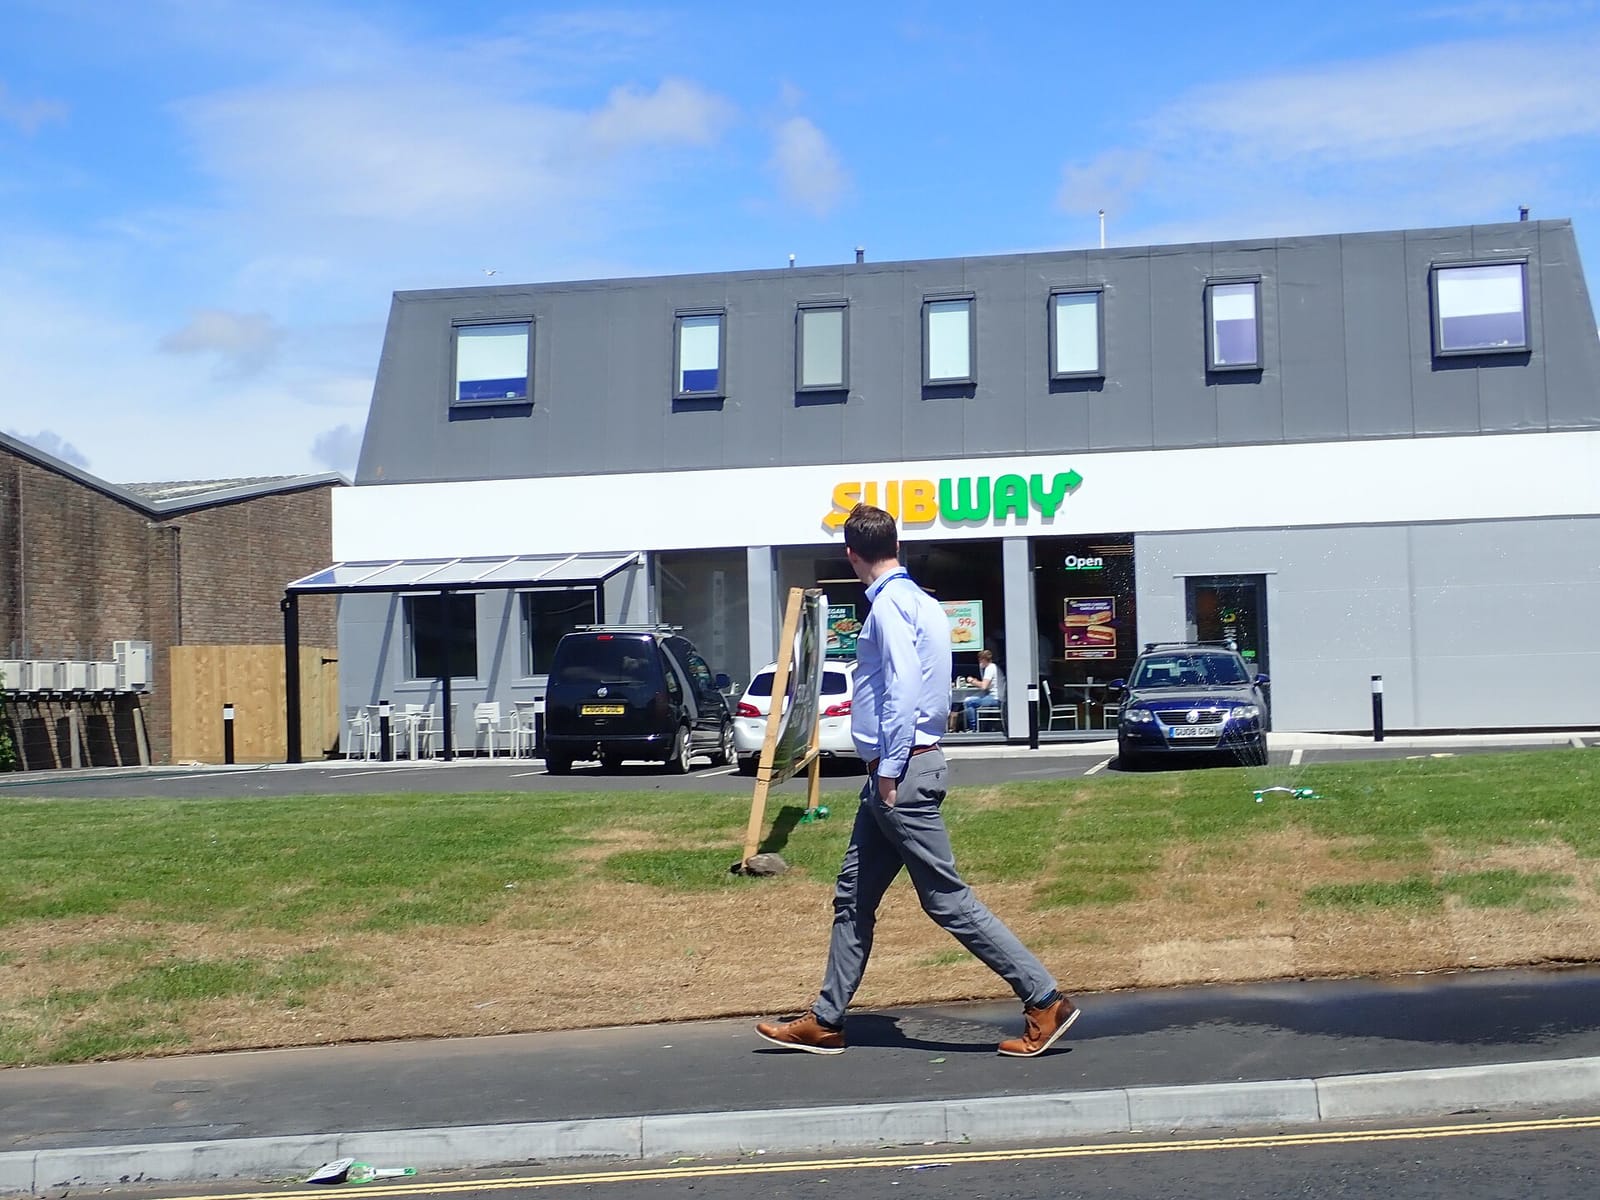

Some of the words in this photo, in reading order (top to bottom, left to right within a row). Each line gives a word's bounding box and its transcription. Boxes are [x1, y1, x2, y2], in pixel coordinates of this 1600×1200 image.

[821, 468, 1083, 531] SUBWAY
[1064, 555, 1103, 569] Open
[958, 617, 977, 628] 99p
